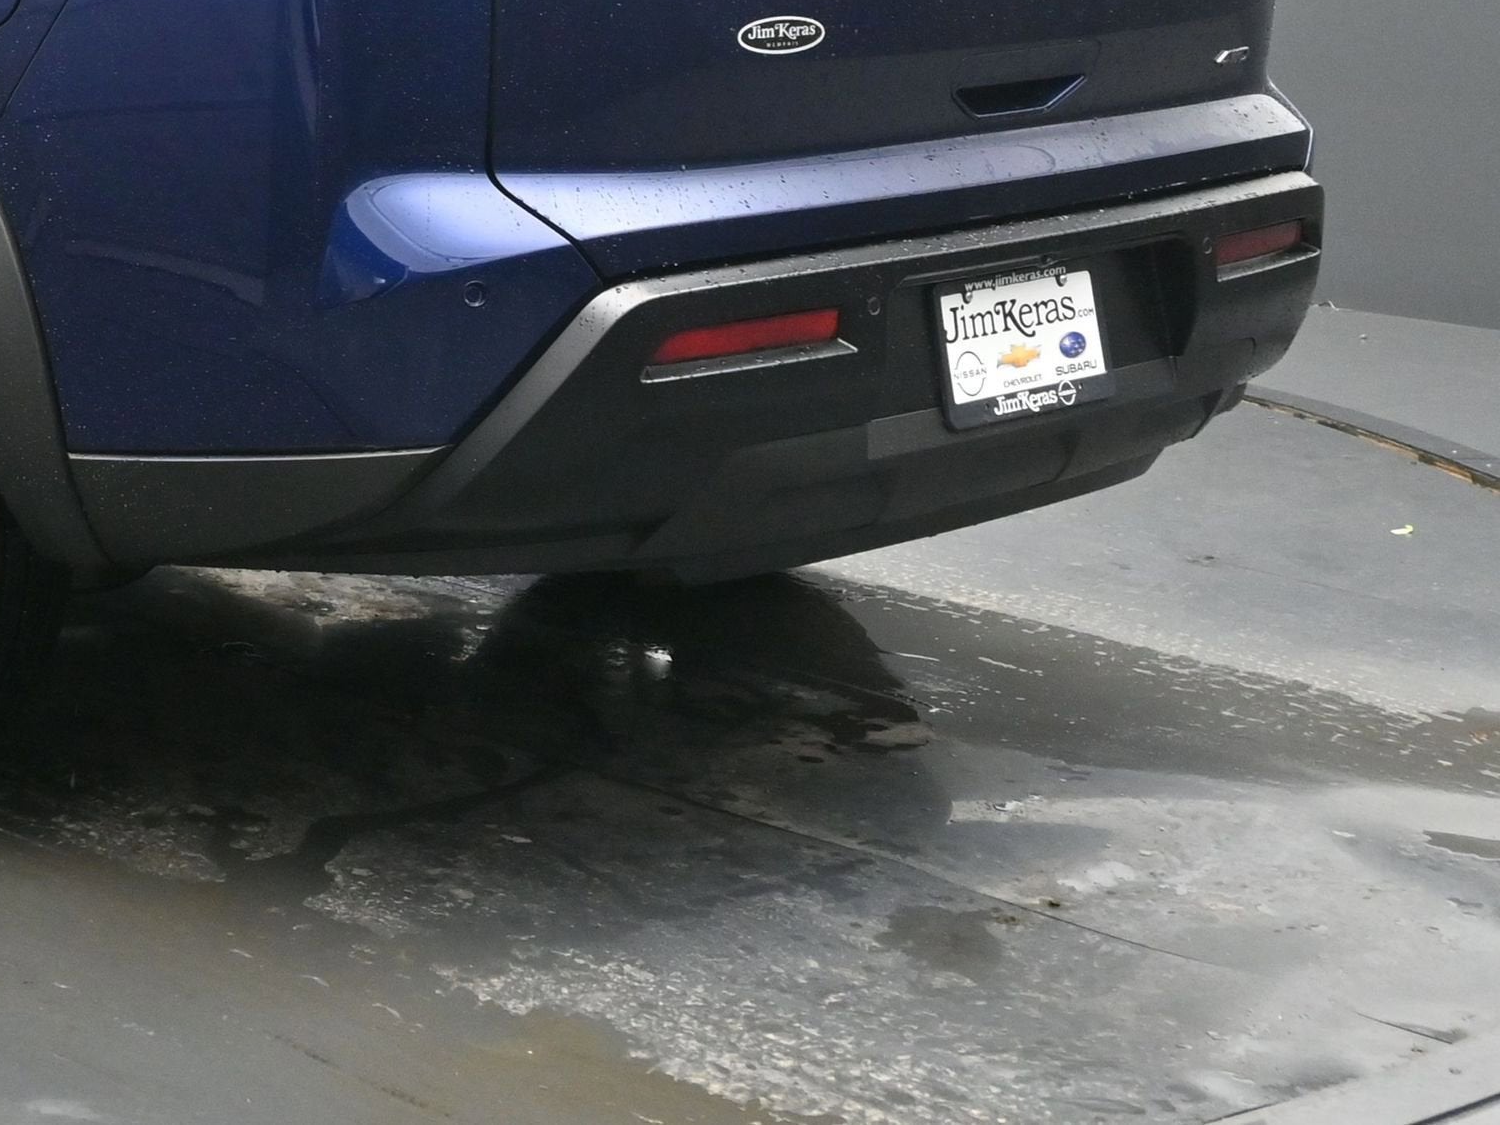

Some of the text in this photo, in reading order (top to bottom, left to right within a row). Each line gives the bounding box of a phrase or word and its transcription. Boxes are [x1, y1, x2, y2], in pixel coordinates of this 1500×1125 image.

[964, 265, 1067, 292] www.jimkeras.com
[953, 367, 988, 379] NISSAN
[1055, 359, 1097, 376] SUBARU
[1003, 373, 1043, 388] CHEVROLET
